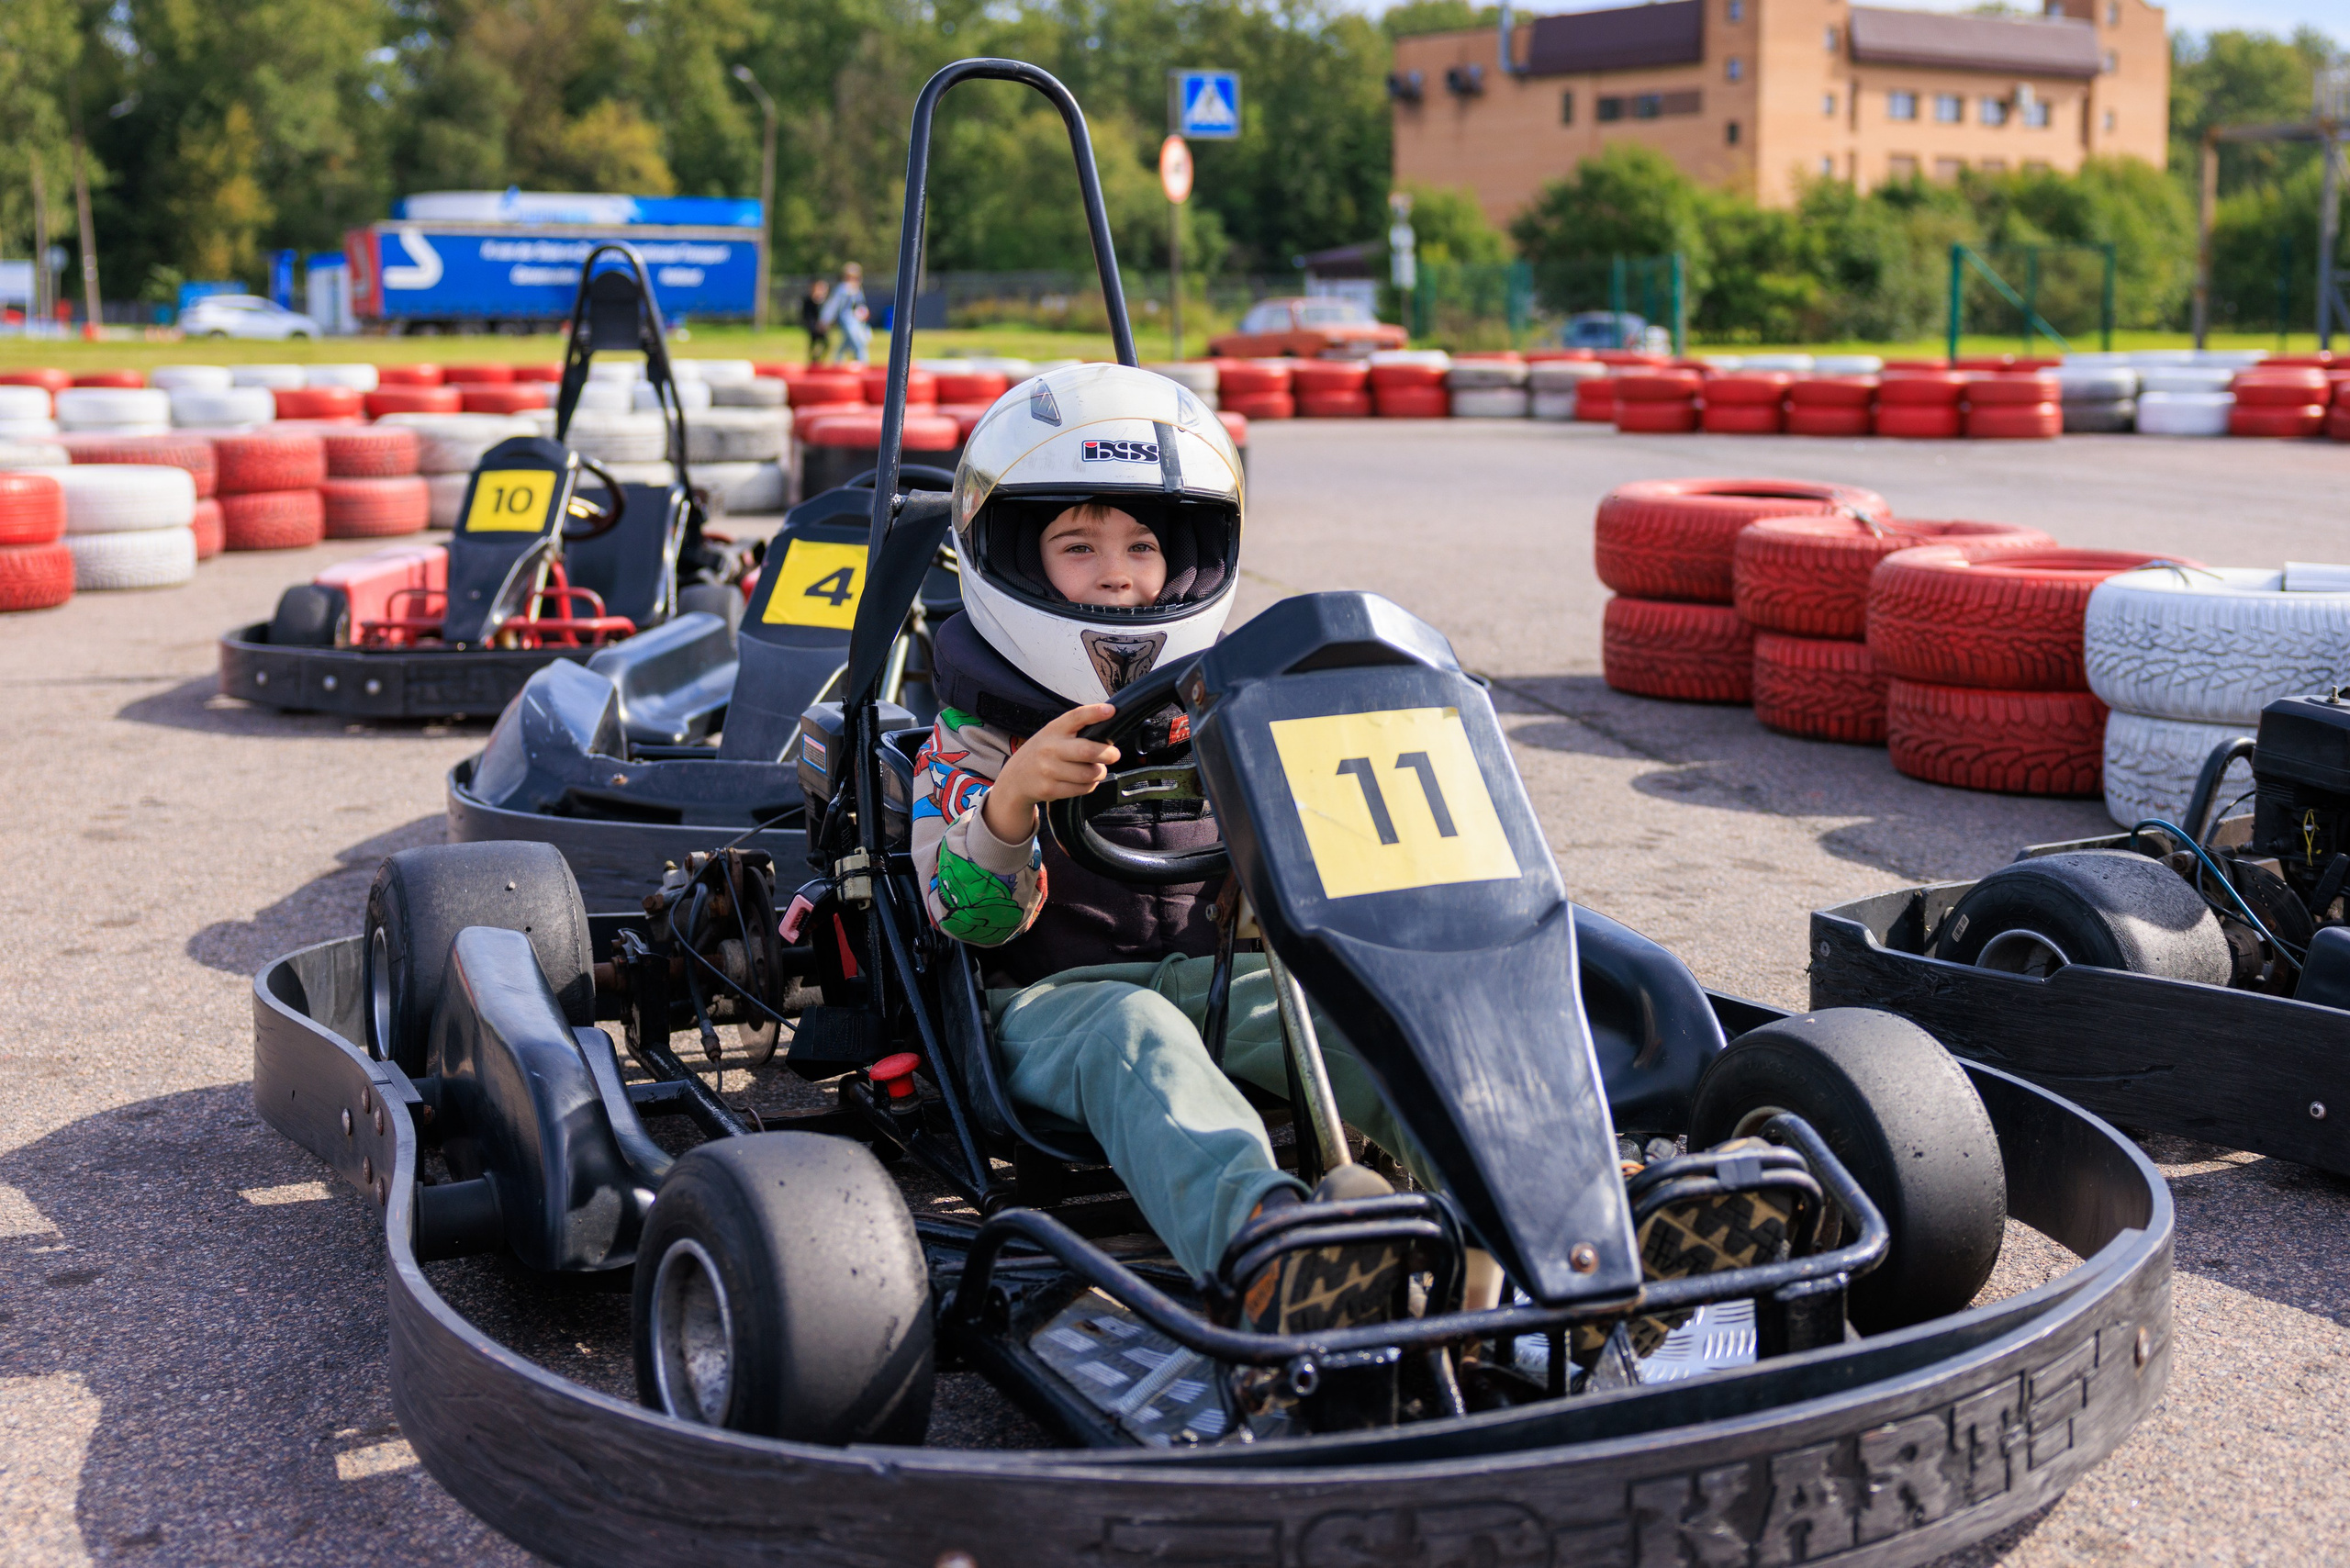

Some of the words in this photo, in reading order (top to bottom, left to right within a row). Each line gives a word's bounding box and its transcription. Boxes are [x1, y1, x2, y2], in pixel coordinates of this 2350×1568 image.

[492, 487, 534, 515] 10
[803, 566, 856, 607] 4
[1336, 751, 1459, 846] 11
